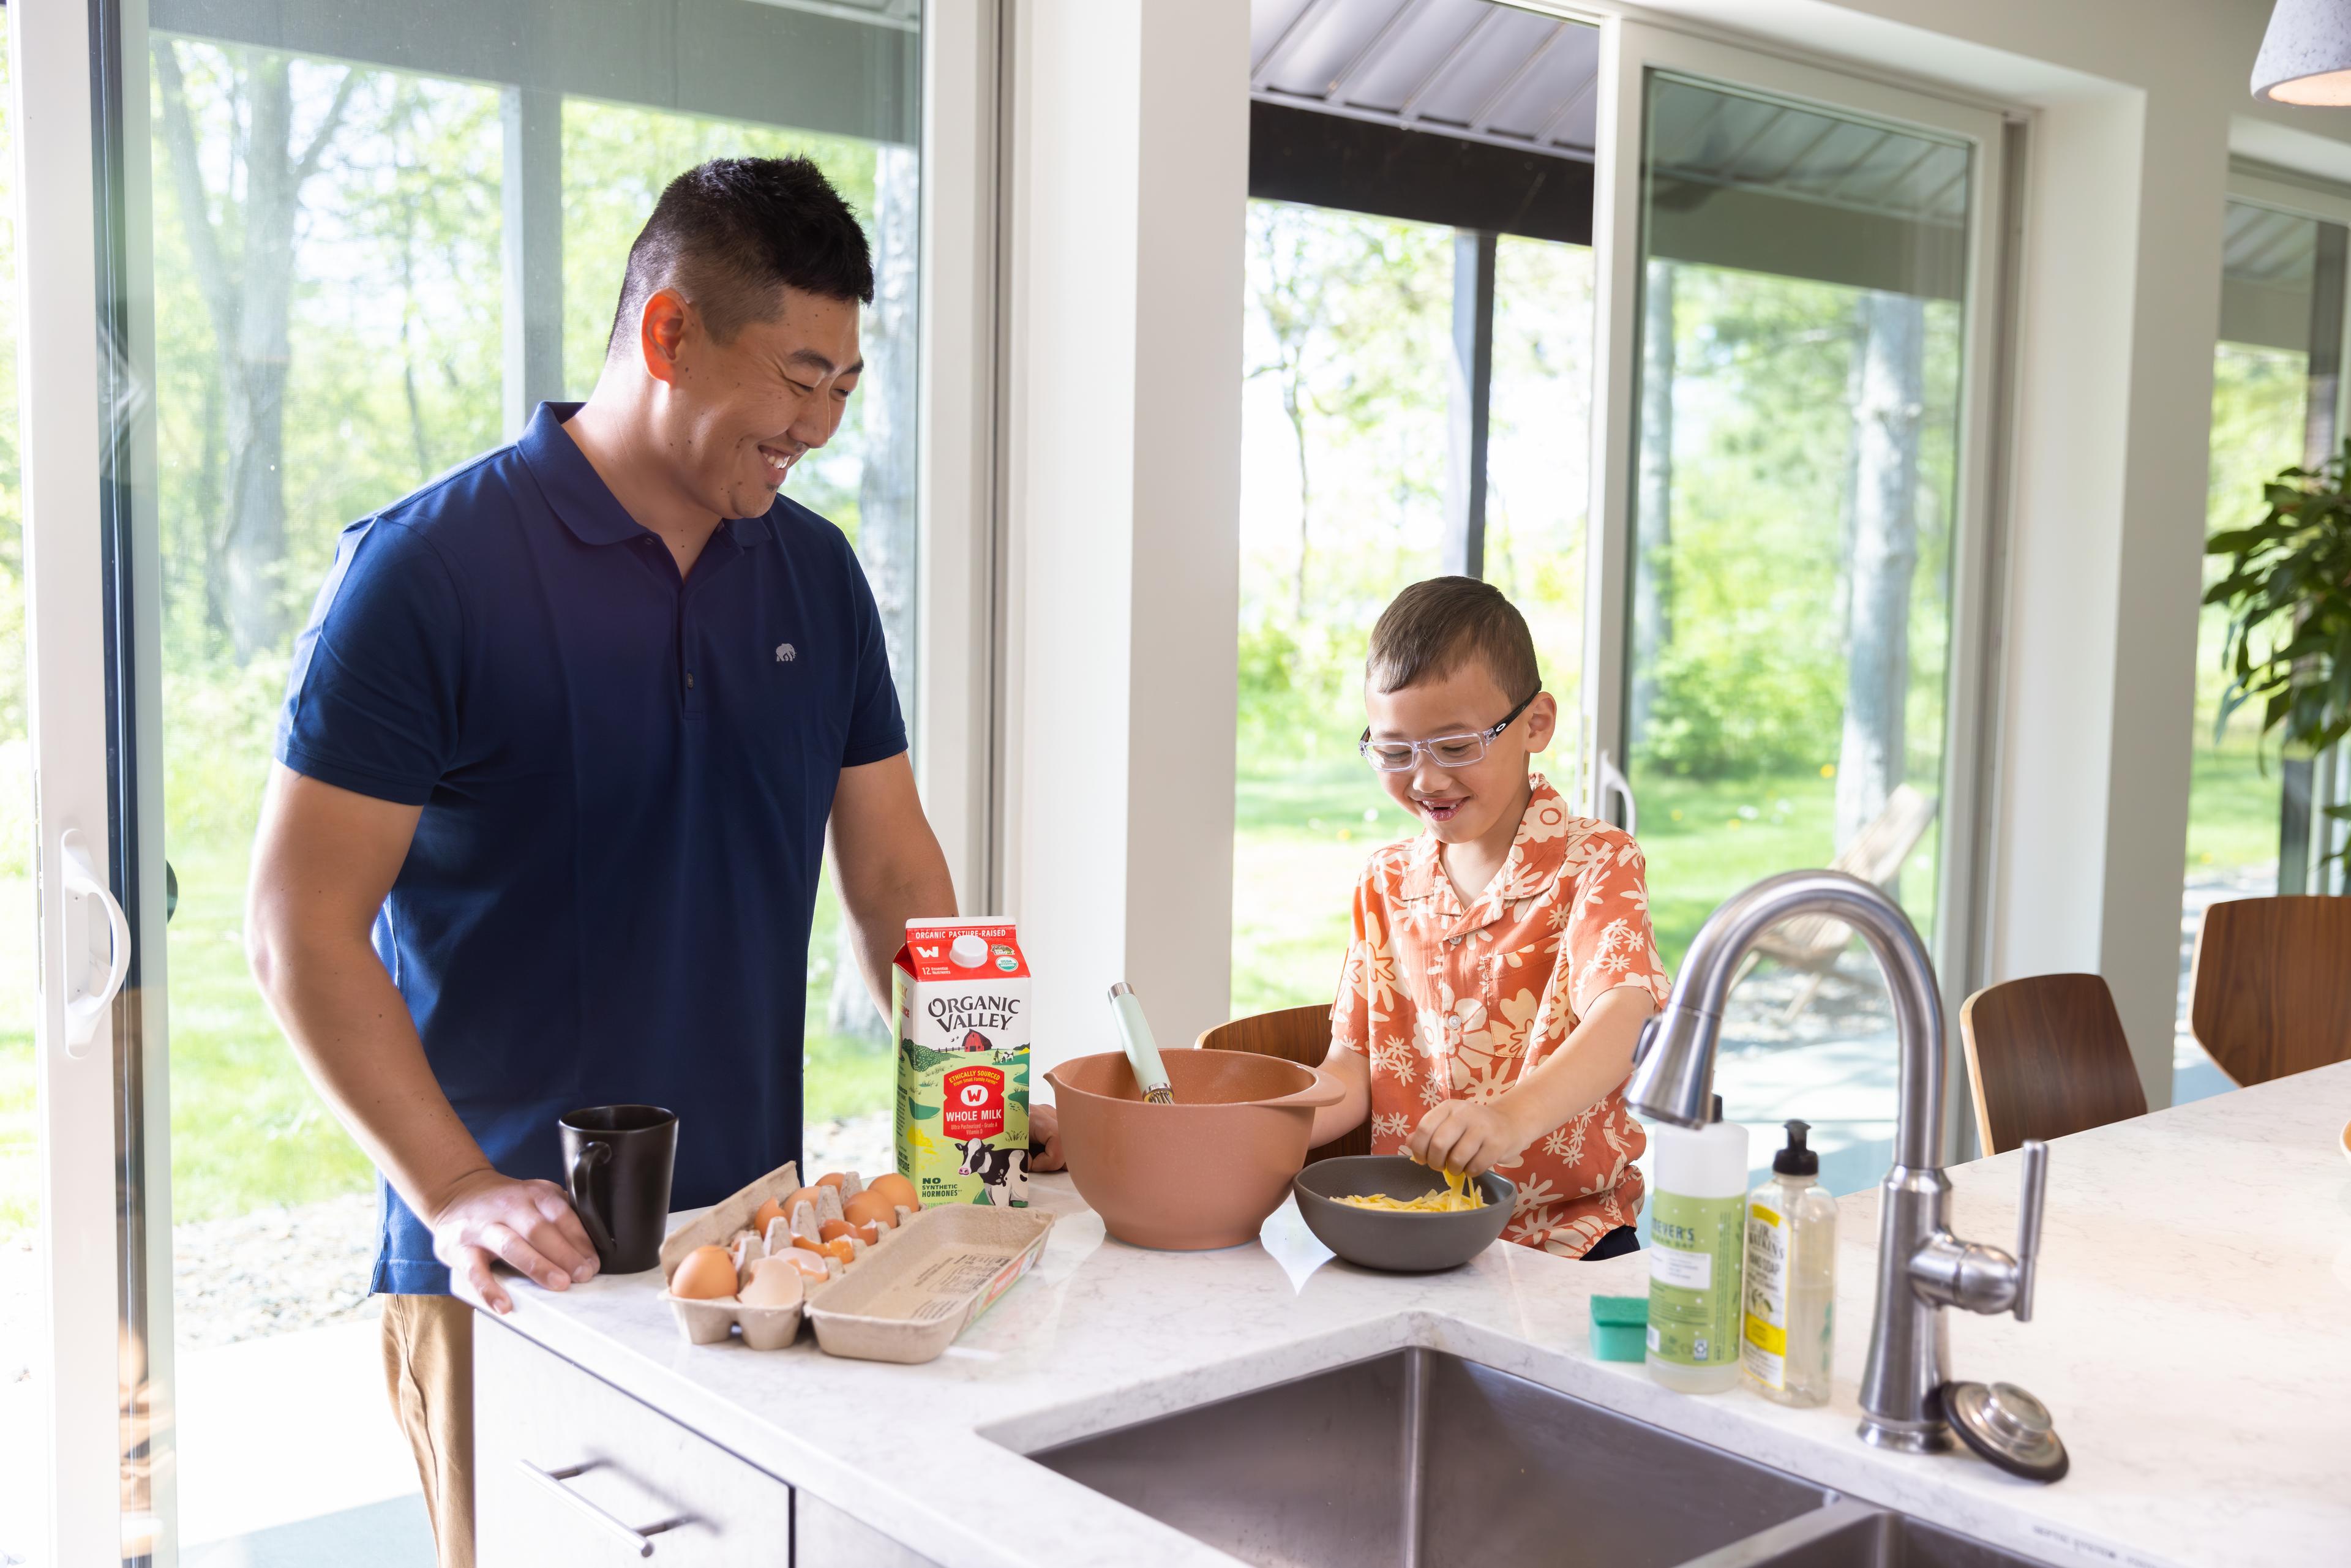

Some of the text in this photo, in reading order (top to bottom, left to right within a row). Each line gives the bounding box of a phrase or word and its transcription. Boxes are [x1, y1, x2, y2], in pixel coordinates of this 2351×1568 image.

[948, 929, 1006, 938] PASTURE-RAISED
[916, 946, 939, 958] W
[921, 967, 932, 975] 12
[928, 995, 1021, 1018] ORGANIC
[948, 1070, 1000, 1084] ETHICALLY SOURCED
[967, 1089, 982, 1102] W
[946, 1109, 1002, 1122] WHOLE MILK
